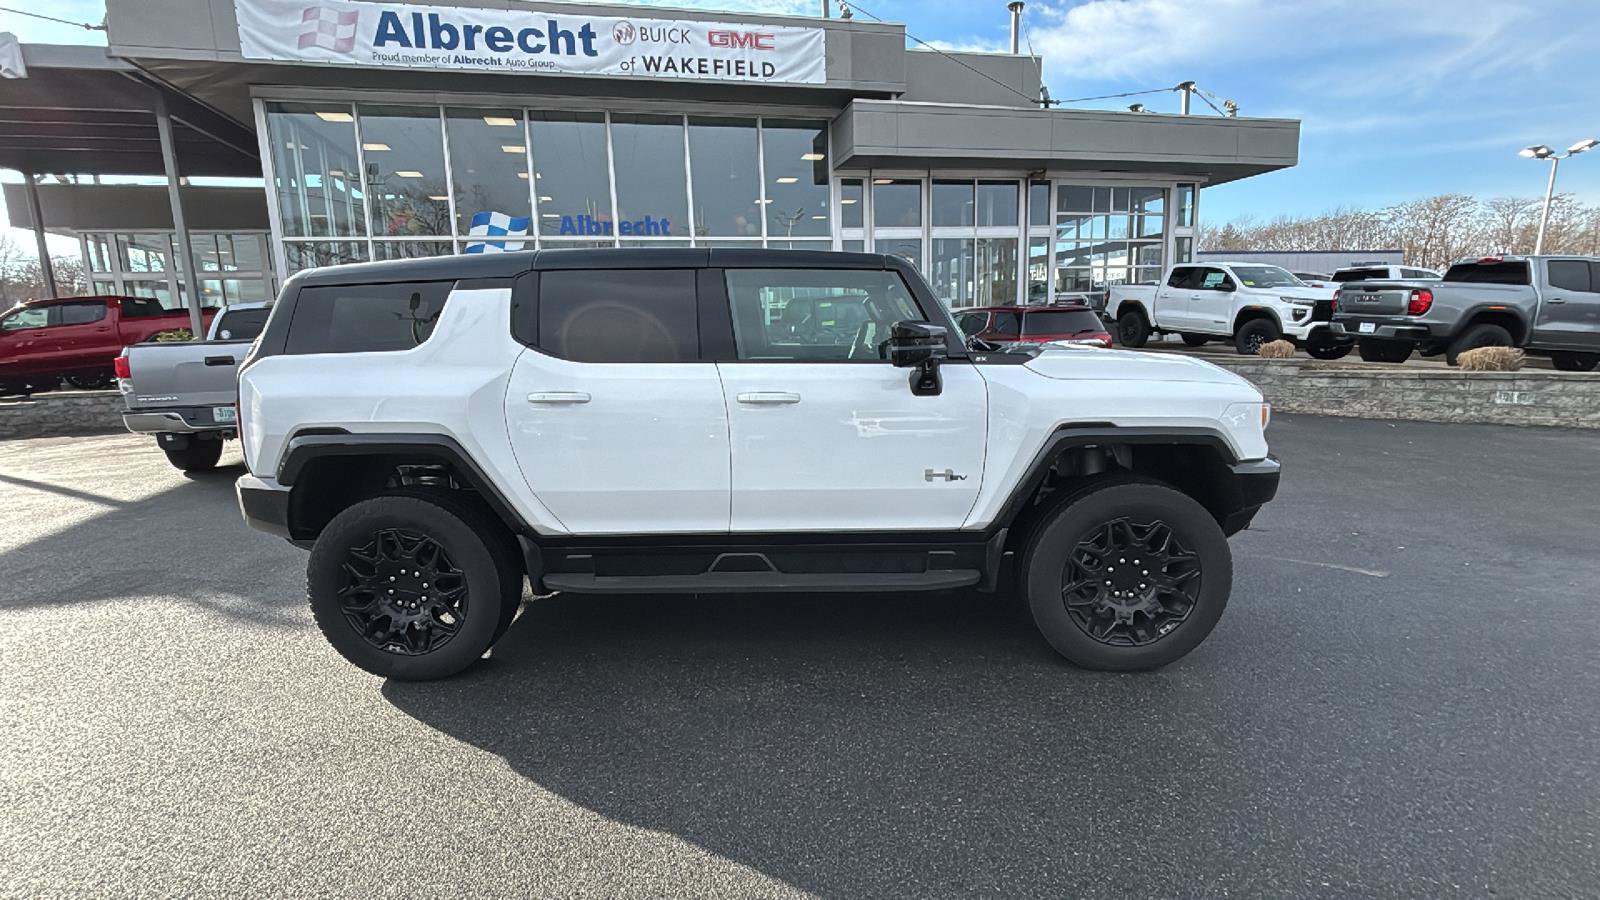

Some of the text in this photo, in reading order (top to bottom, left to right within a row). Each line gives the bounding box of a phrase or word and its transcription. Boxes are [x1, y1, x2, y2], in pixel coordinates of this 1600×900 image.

[373, 10, 598, 57] Albrecht
[639, 26, 775, 50] BUICK GMC
[372, 52, 555, 69] Proud member of Albrecht Auto Group
[620, 55, 775, 77] of WAKEFIELD
[560, 214, 671, 236] Albrecht
